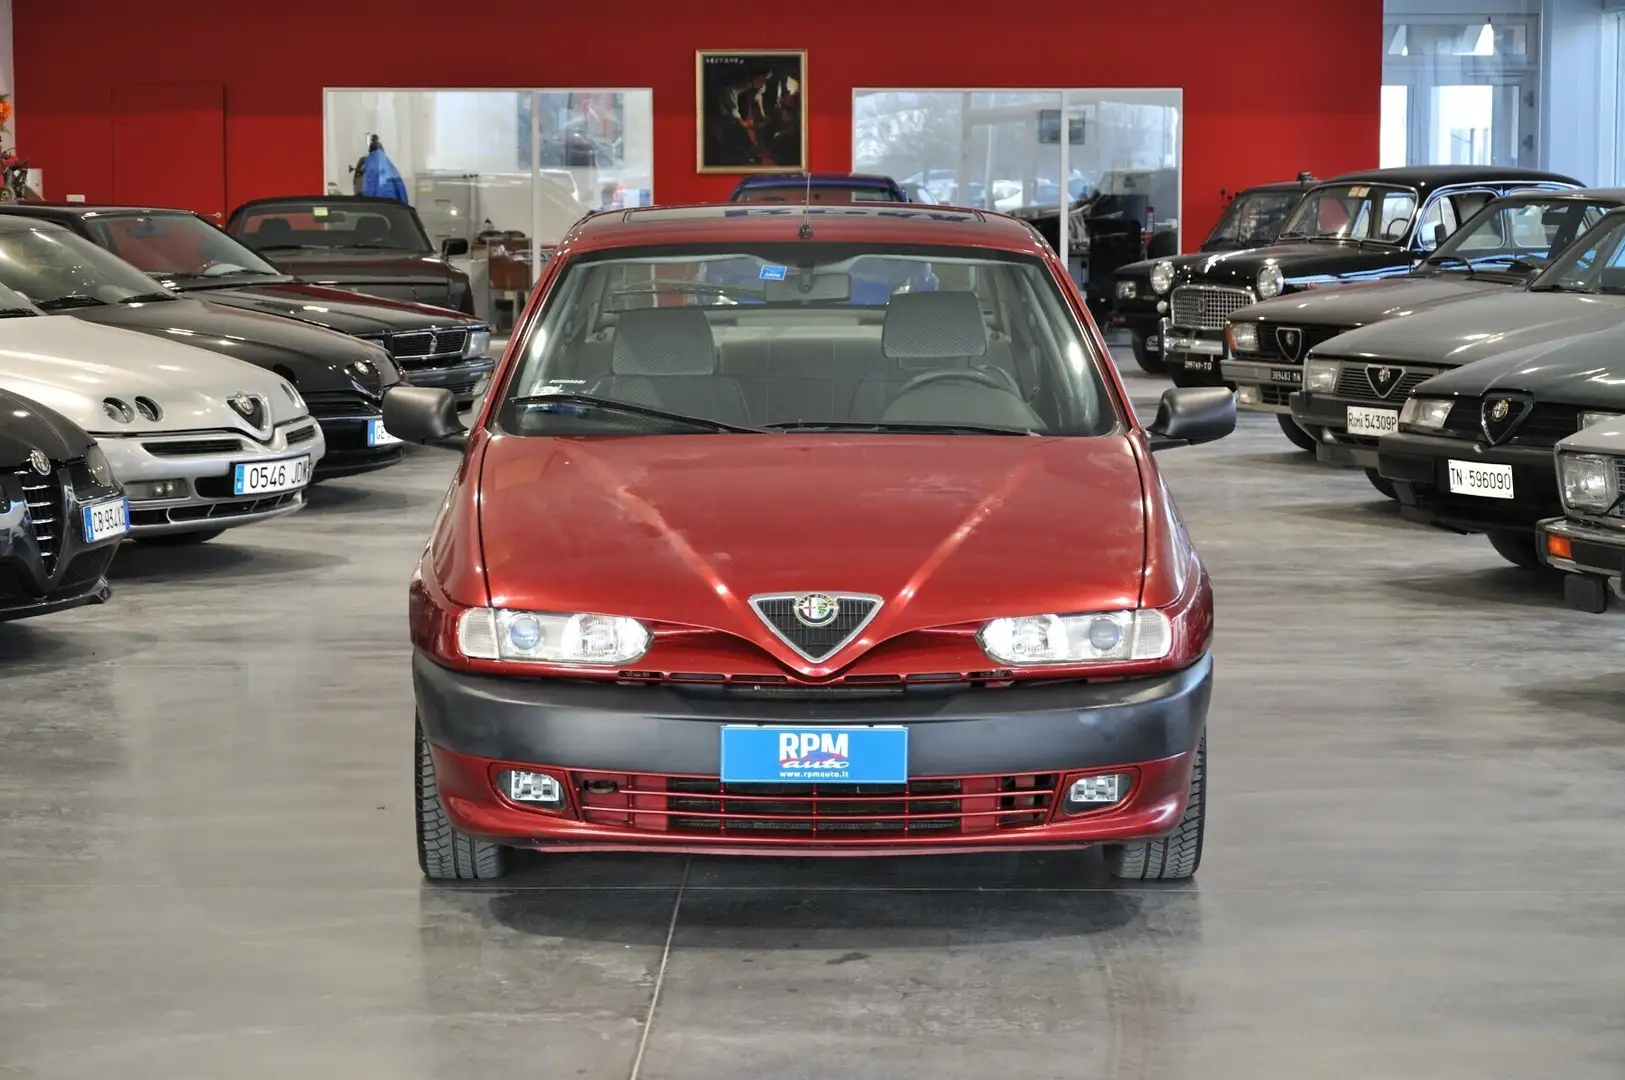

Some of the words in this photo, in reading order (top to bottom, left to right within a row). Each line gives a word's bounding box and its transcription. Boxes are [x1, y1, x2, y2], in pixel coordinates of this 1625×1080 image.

[1365, 414, 1397, 431] 54309P
[250, 465, 286, 489] 0546
[1450, 467, 1463, 486] TN
[1469, 469, 1511, 490] 596090
[779, 732, 849, 760] RPM
[780, 757, 850, 769] auto
[779, 770, 850, 780] www.rpmauto.it
